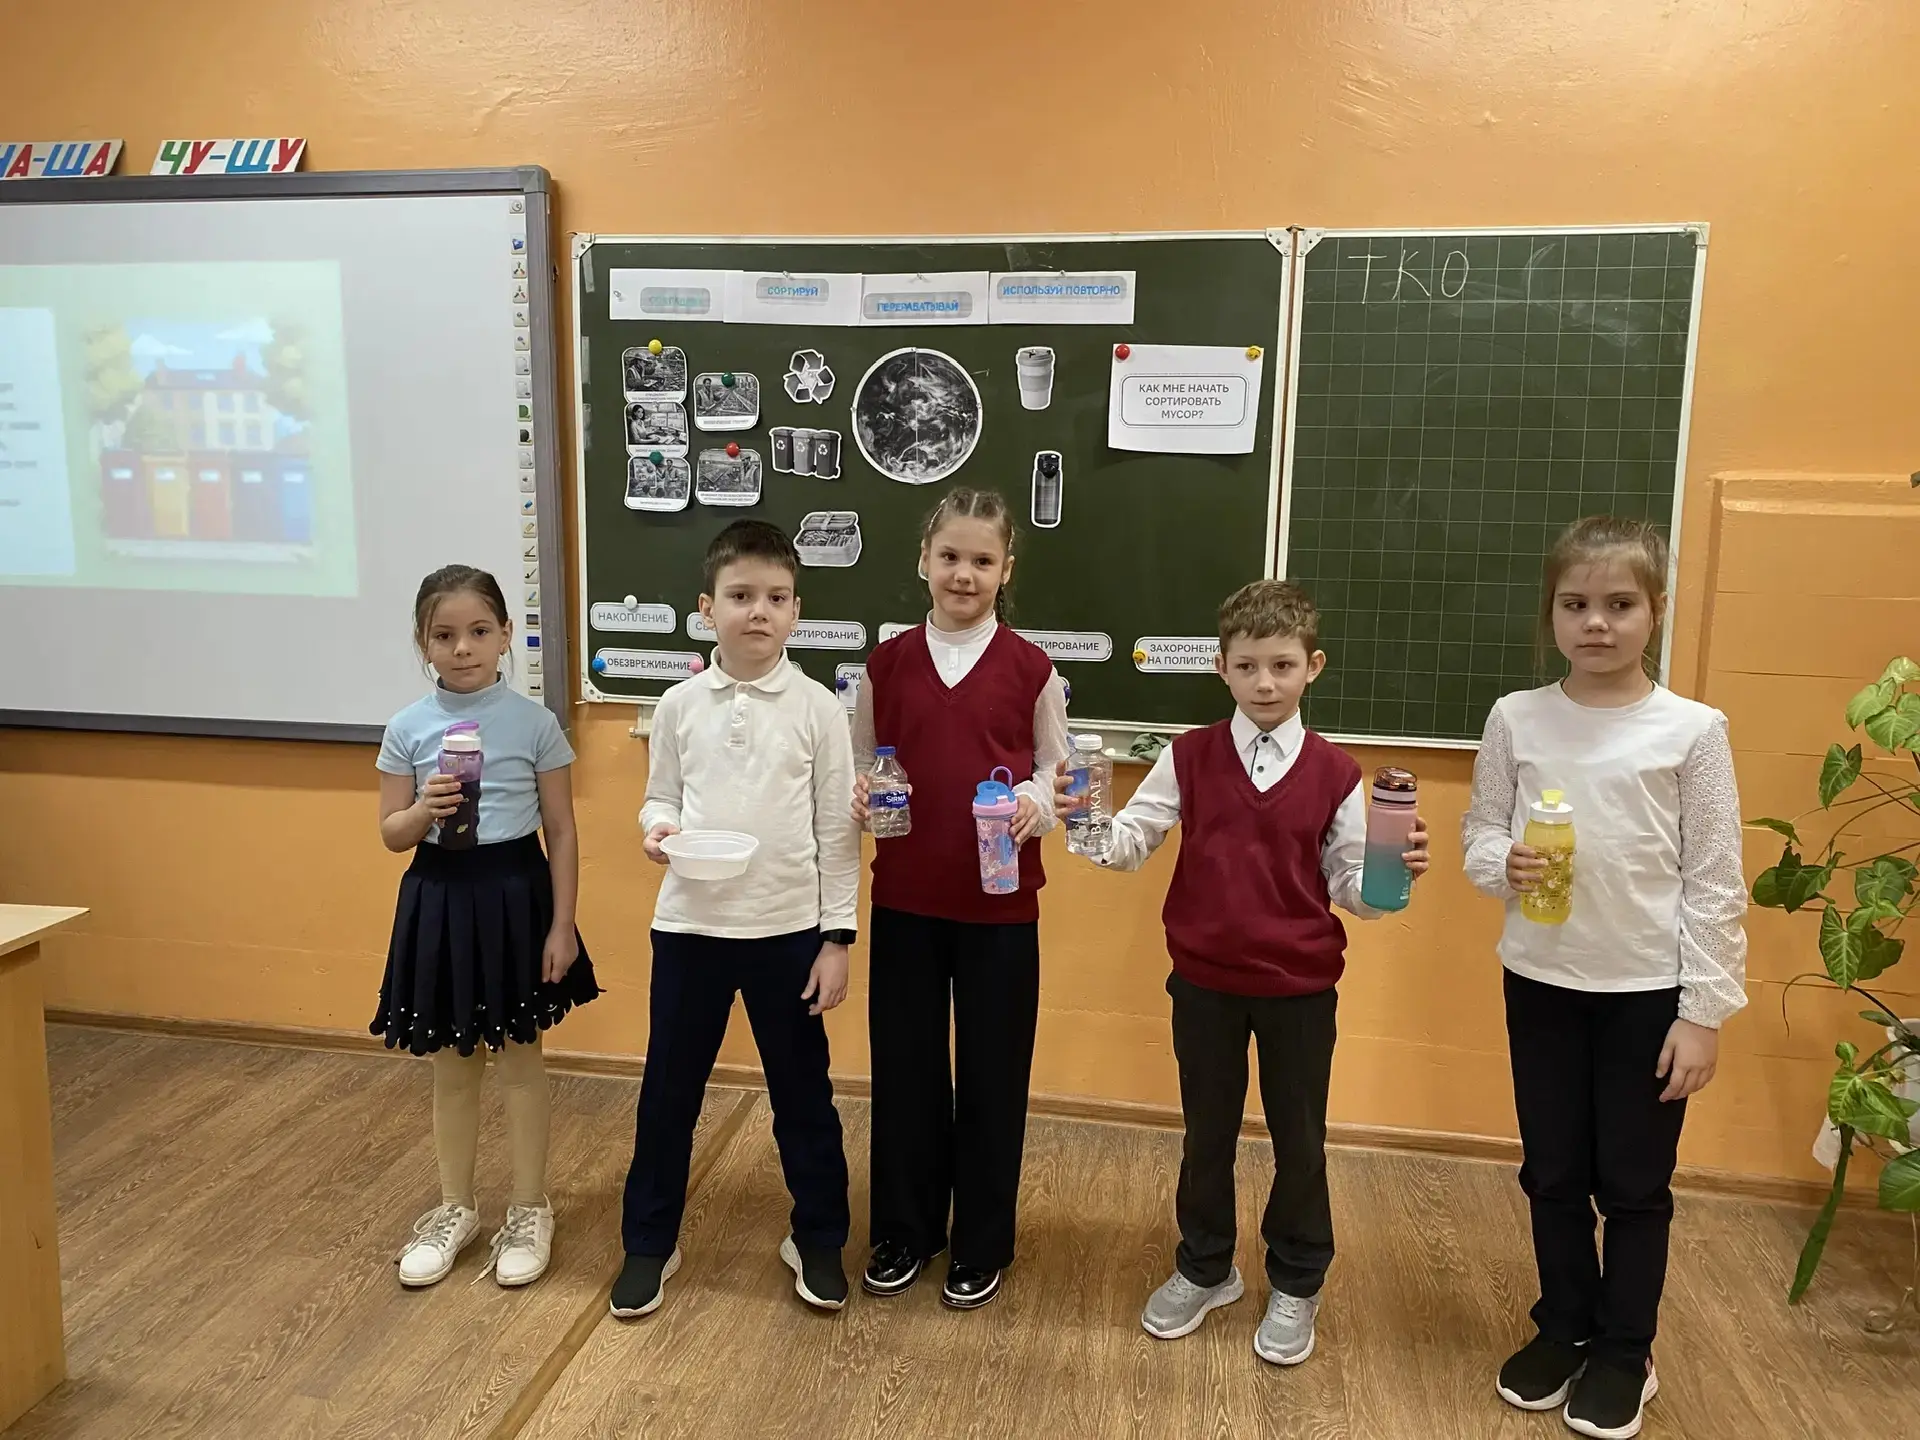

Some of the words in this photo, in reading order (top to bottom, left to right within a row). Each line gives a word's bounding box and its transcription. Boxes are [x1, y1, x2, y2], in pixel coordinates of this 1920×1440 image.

[160, 138, 304, 174] ЧУ-ЩУ
[1348, 249, 1469, 304] ТКО
[767, 286, 818, 296] СОРТИРУЙ
[1003, 284, 1062, 295] ИСПОЛЬЗУЙ
[1065, 285, 1120, 295] ПОВТОРНО
[877, 300, 958, 312] ПЕРЕРАБАТЫВАЙ
[1139, 384, 1160, 393] КАК
[1162, 384, 1185, 393] МНЕ
[1188, 384, 1229, 393] НАЧАТЬ
[1145, 397, 1221, 406] СОРТИРОВАТЬ
[1161, 410, 1204, 419] МУСОР?
[598, 612, 668, 623] НАКОПЛЕНИЕ
[788, 630, 860, 640] ОРТИРОВАНИЕ
[1150, 644, 1220, 653] ЗАХОРОНЕНИ
[1148, 656, 1161, 665] НА
[1164, 656, 1214, 665] ПОЛИГОН
